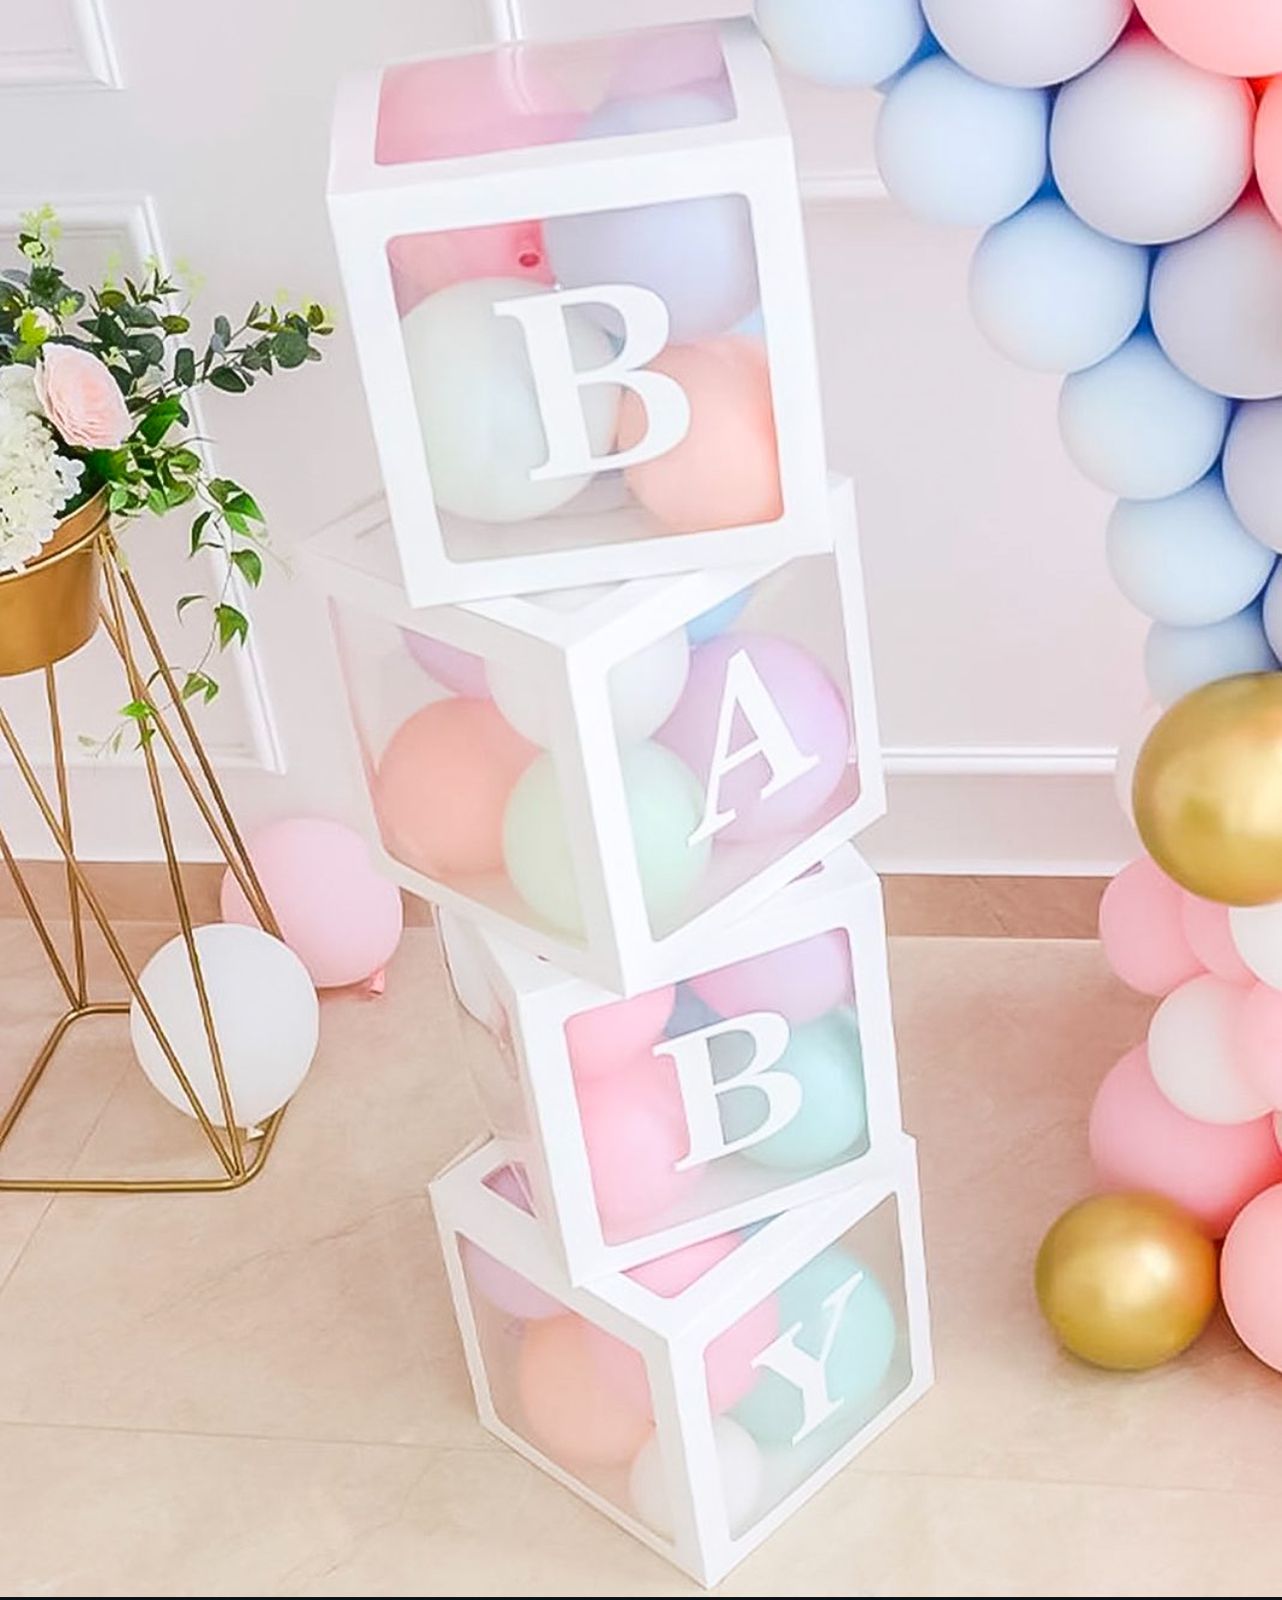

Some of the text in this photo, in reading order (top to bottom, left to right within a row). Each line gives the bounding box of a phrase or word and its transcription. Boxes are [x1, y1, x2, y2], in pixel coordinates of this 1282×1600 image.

[493, 284, 691, 482] B
[687, 648, 821, 847] A
[652, 1011, 804, 1172] B
[751, 1270, 863, 1447] Y
